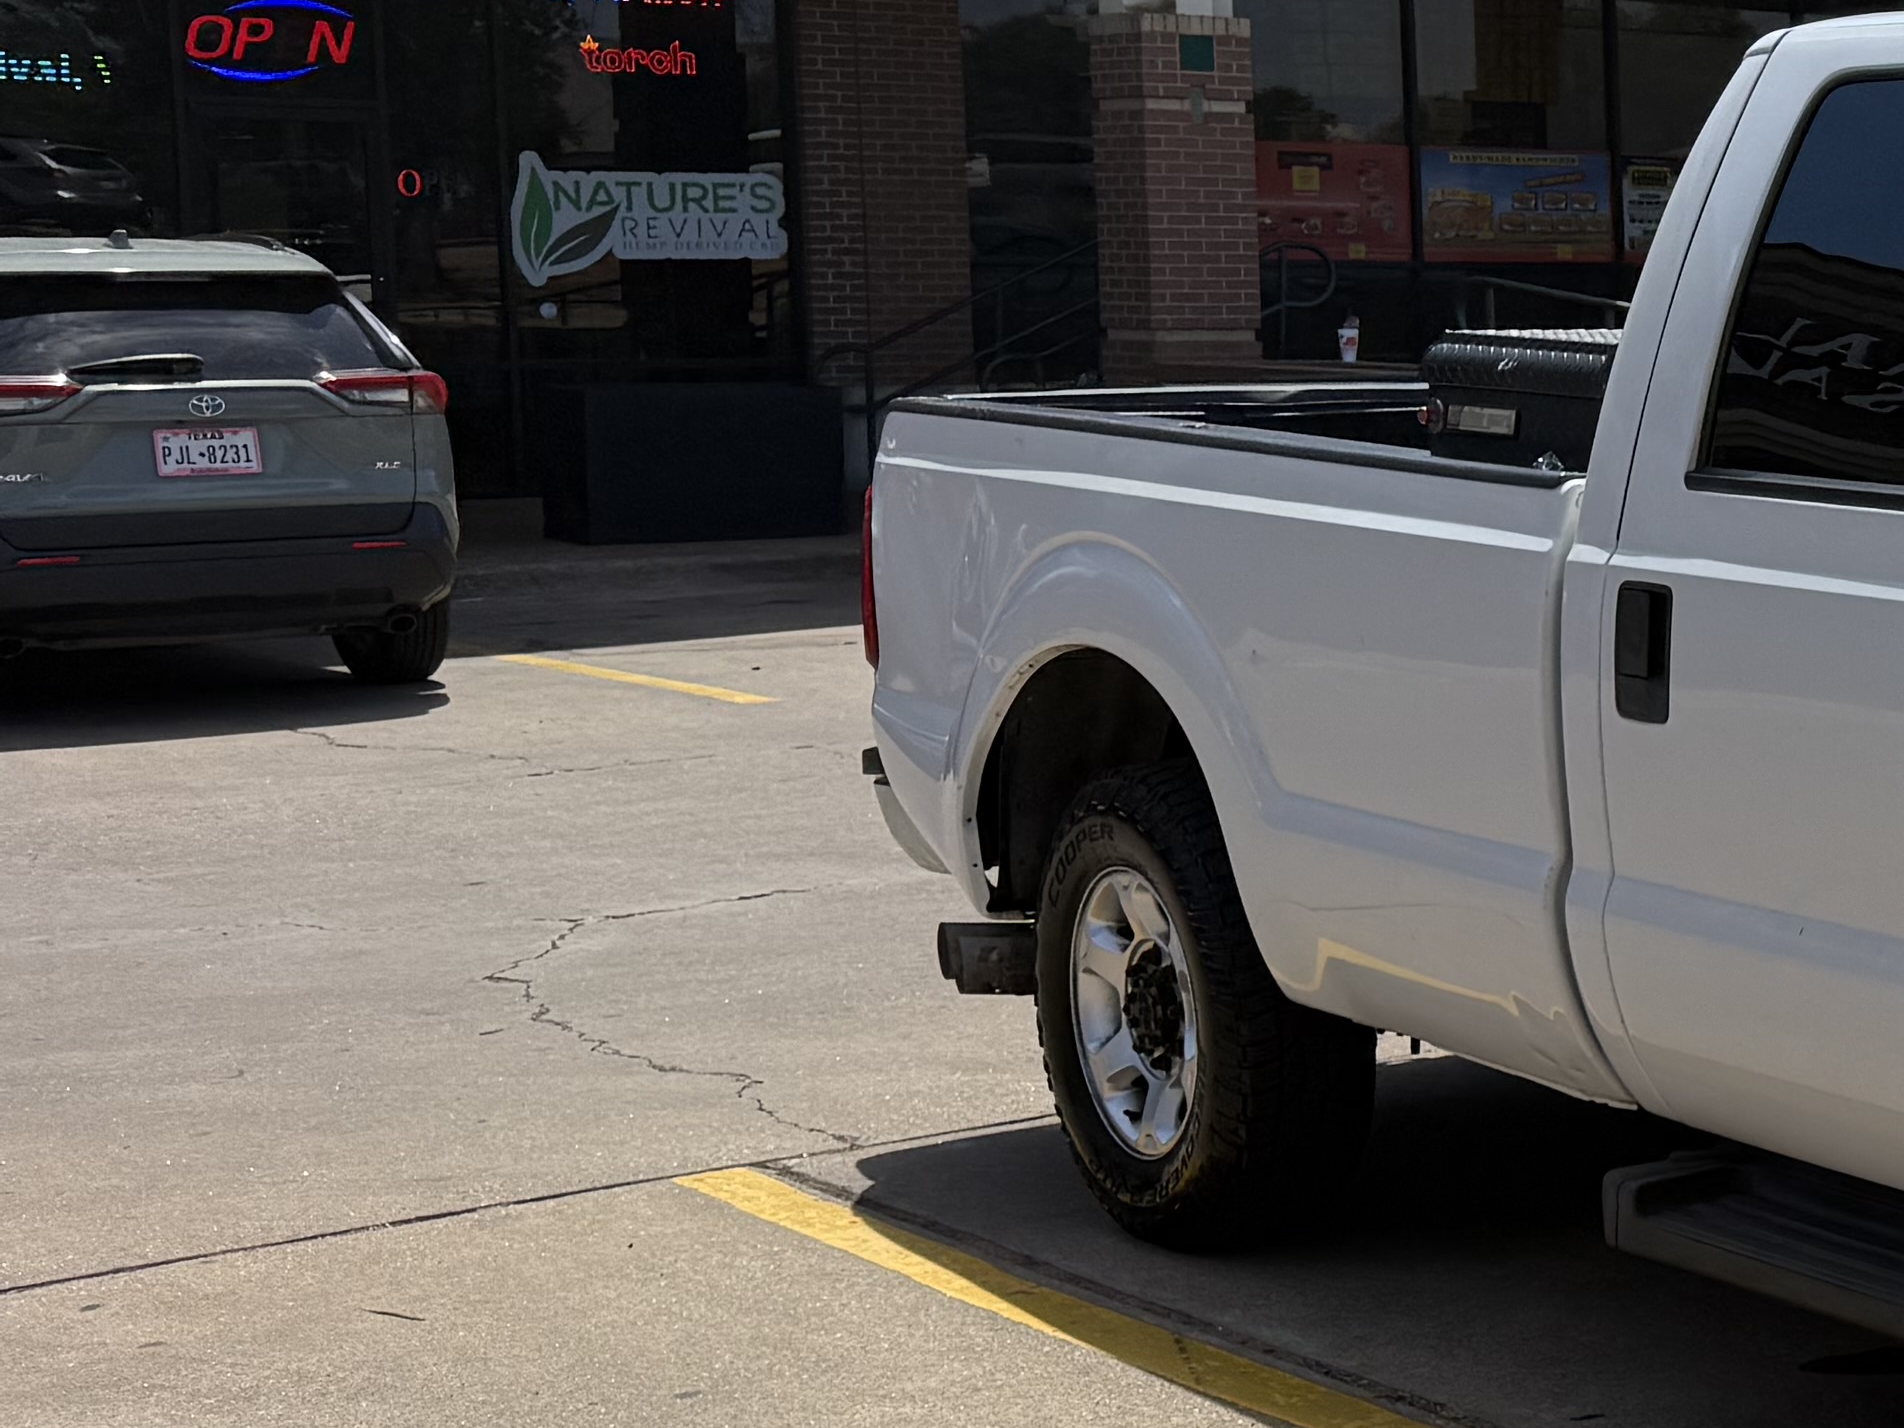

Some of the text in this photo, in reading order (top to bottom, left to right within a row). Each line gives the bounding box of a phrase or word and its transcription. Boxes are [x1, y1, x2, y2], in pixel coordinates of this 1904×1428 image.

[184, 14, 357, 65] OPN
[579, 39, 697, 75] torch
[553, 179, 776, 215] NATURE'S
[621, 216, 780, 240] REVIVAL
[1047, 823, 1115, 908] COOPER
